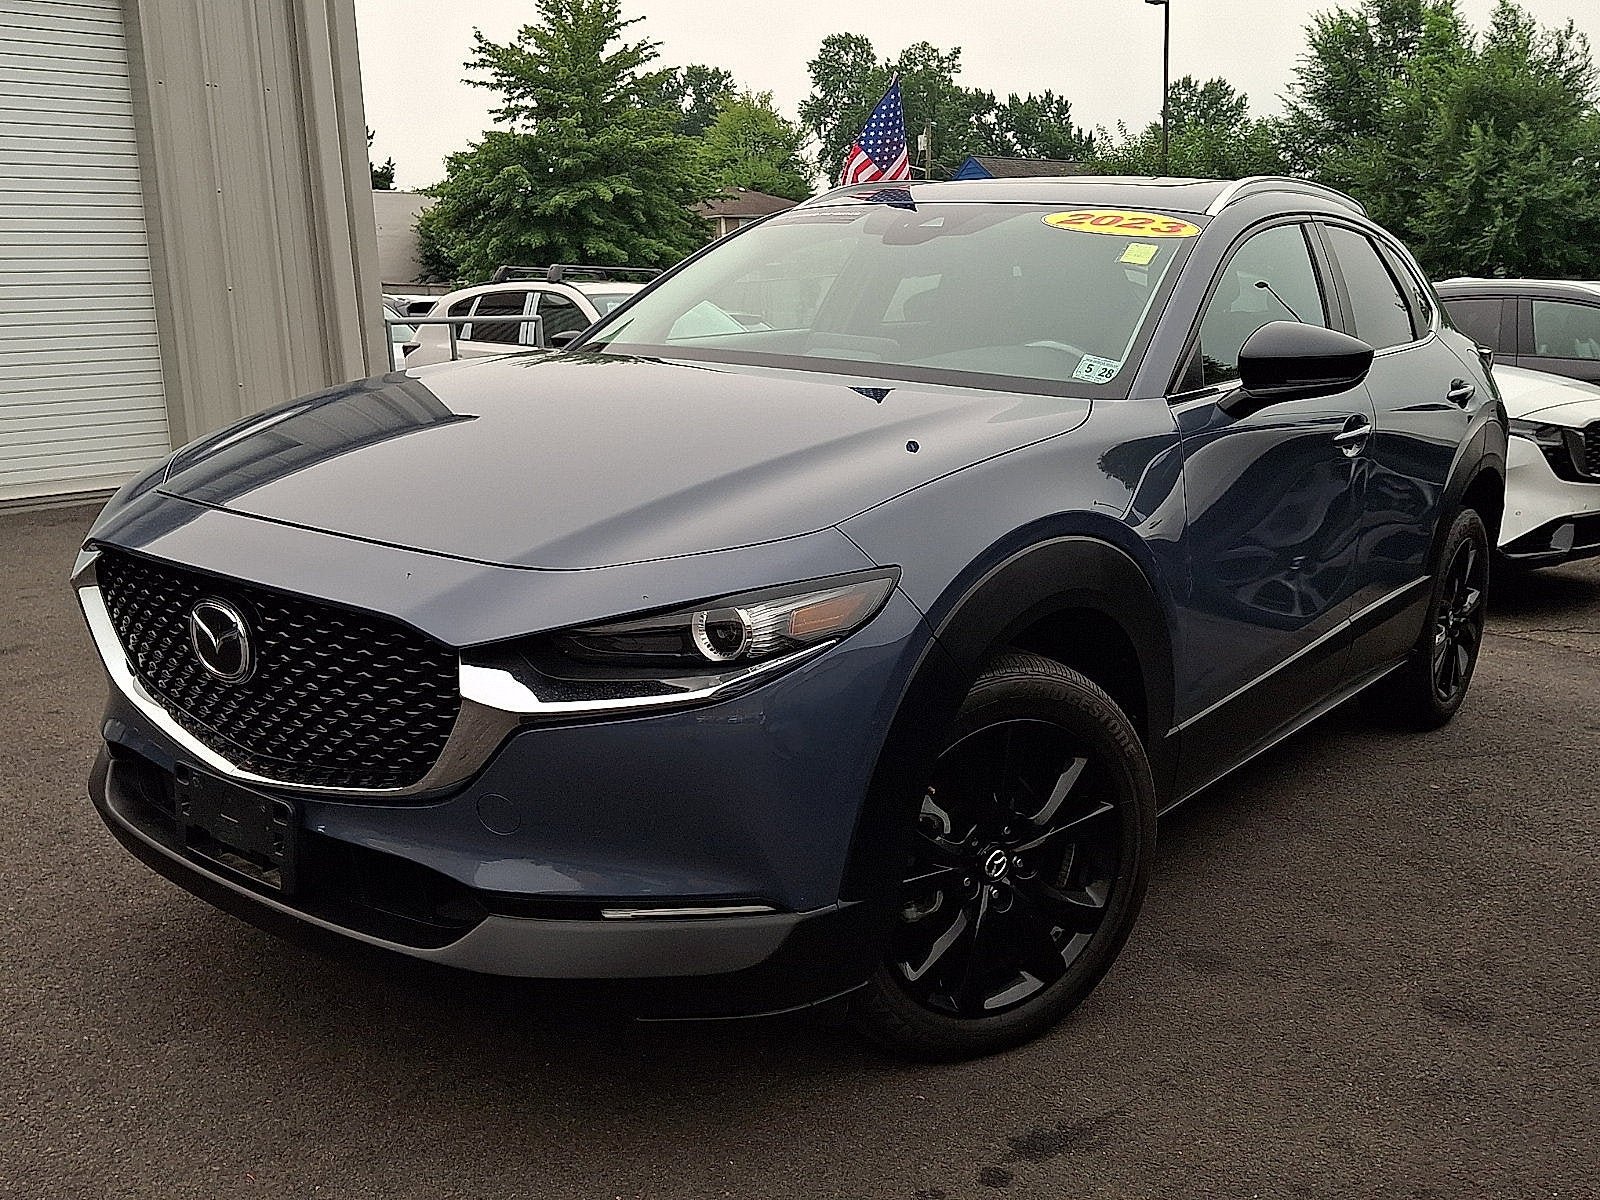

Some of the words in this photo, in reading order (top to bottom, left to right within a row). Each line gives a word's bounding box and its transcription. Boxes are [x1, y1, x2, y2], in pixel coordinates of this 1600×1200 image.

[1056, 213, 1187, 233] 2023
[1084, 363, 1095, 373] 5
[1098, 367, 1114, 379] 28
[1016, 679, 1139, 758] DGESTONE
